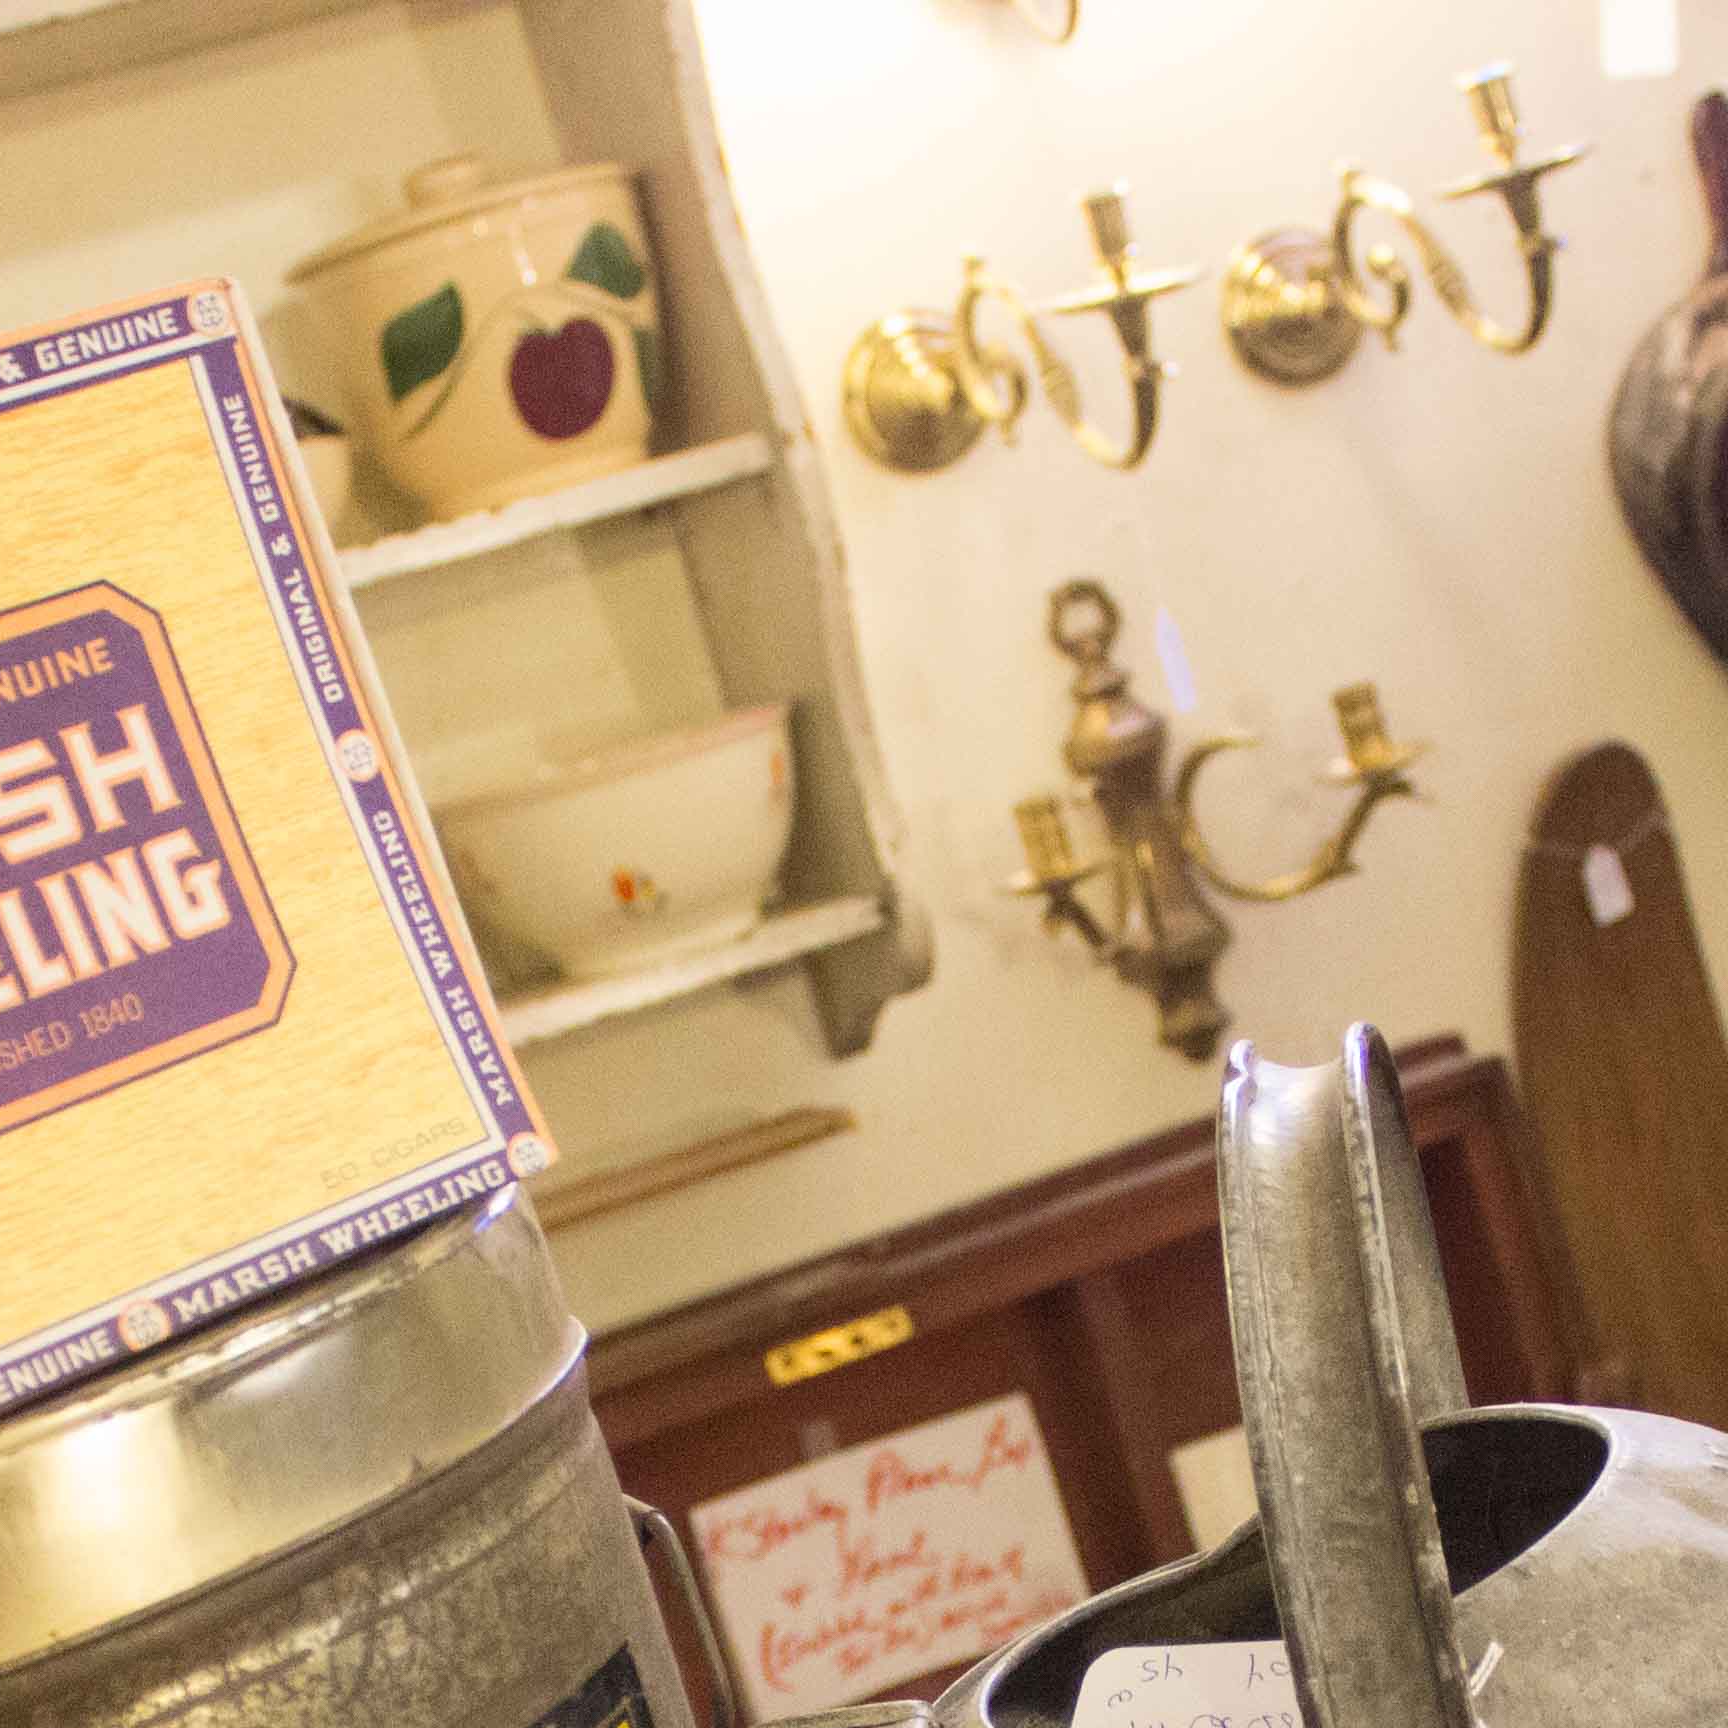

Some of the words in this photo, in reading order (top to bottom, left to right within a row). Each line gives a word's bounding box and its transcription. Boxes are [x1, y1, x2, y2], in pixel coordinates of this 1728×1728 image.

[32, 306, 181, 372] GENUINE
[222, 393, 281, 524] GENUINE
[271, 533, 293, 557] &
[282, 566, 346, 705] ORIGINAL
[372, 808, 460, 981] WHEELING
[80, 992, 147, 1042] 1840
[444, 982, 514, 1107] MARSH
[169, 1243, 315, 1326] MARSH
[320, 1157, 508, 1256] WHEELING
